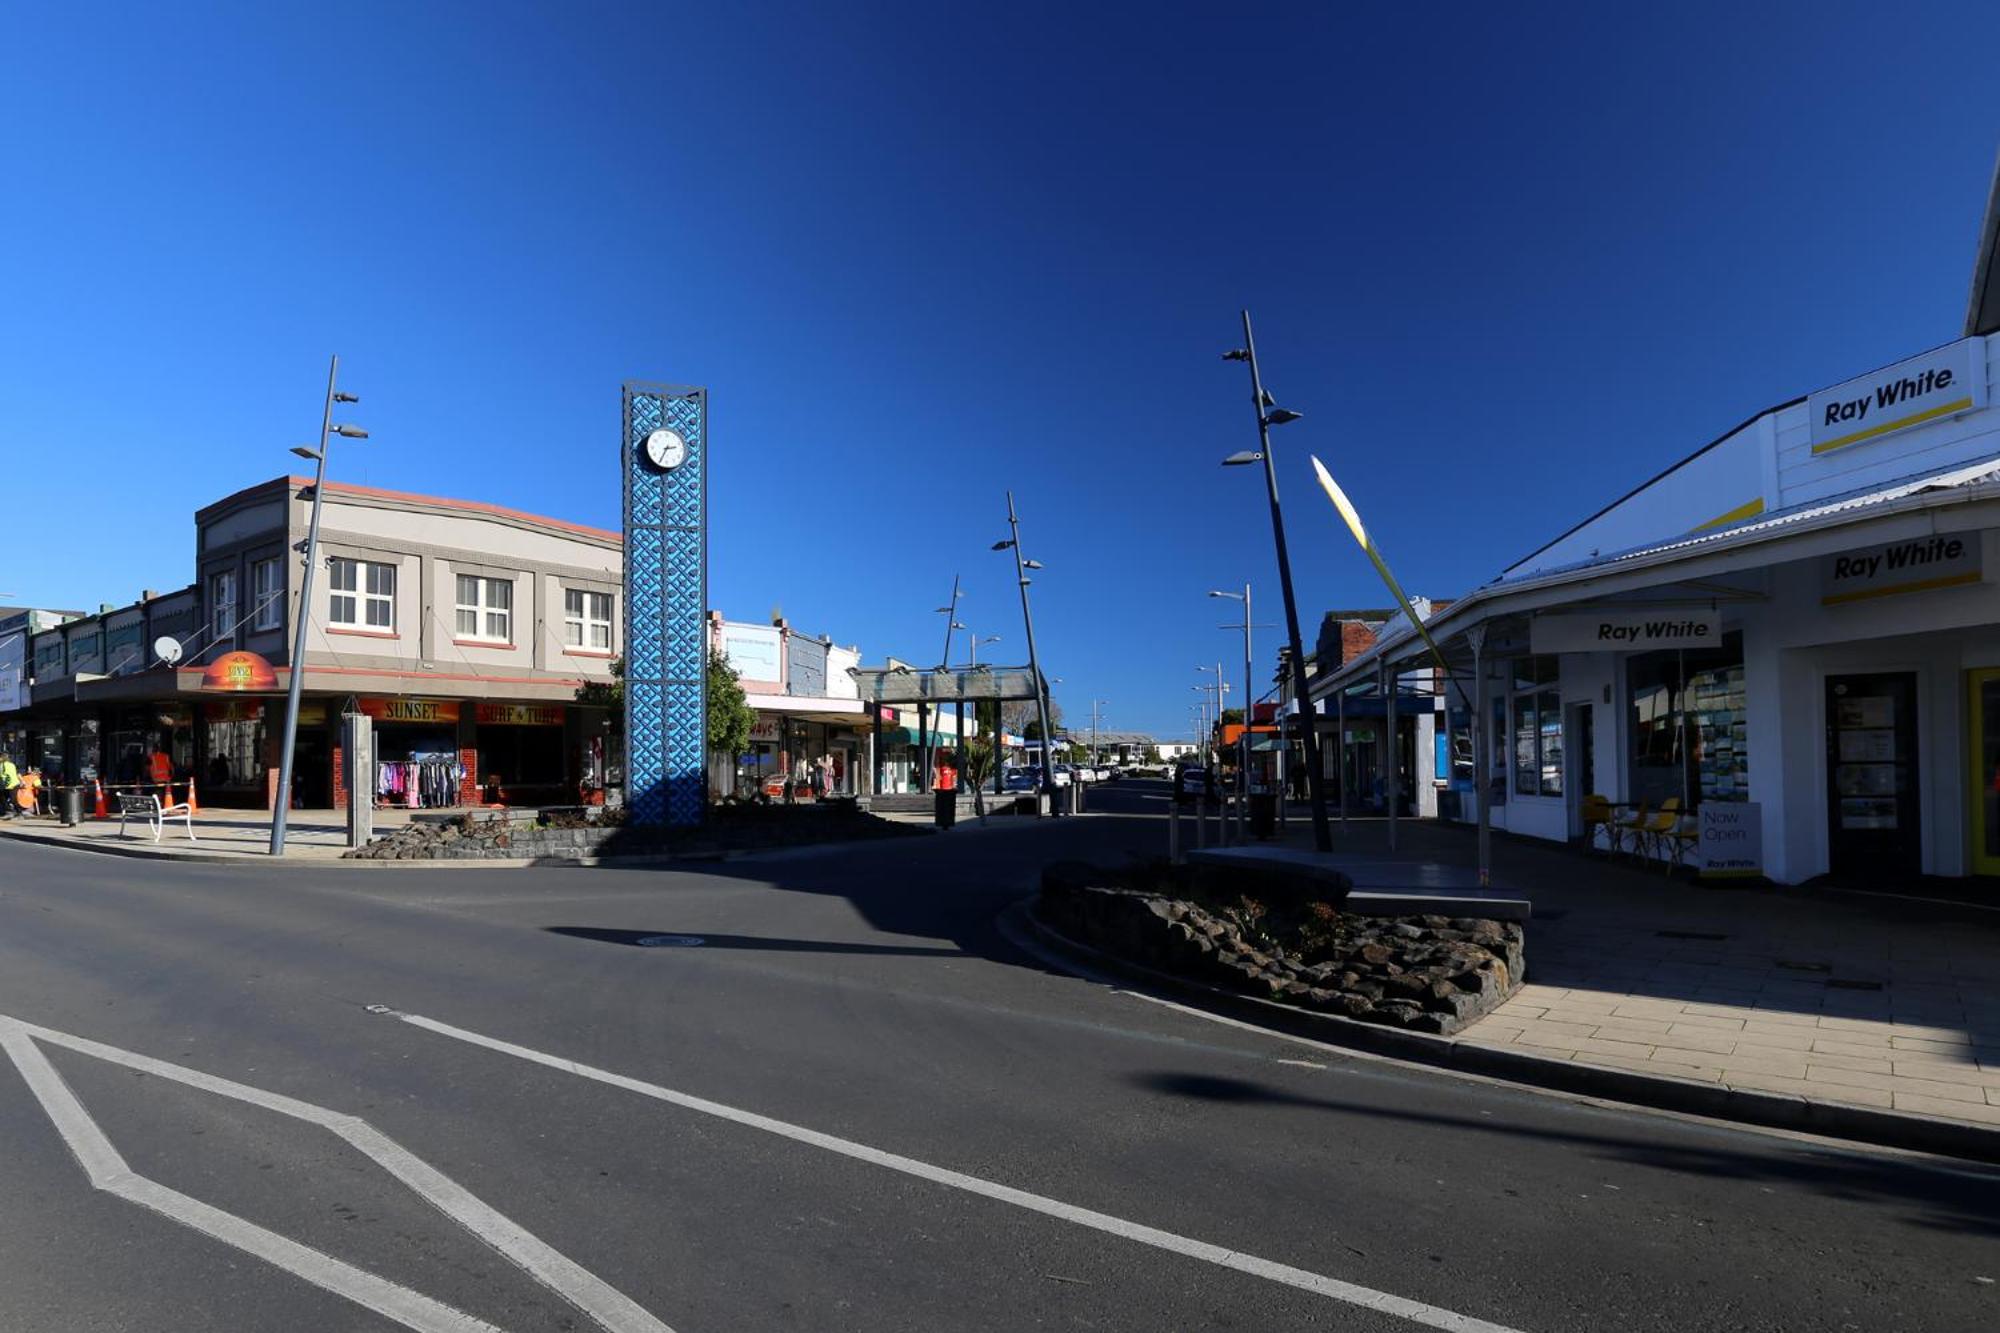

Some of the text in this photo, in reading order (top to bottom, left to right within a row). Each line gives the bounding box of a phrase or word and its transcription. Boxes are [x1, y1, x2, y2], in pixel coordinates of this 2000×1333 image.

[1824, 368, 1953, 426] Ray White
[1834, 537, 1963, 580] Ray White
[1598, 620, 1709, 642] Ray White
[385, 702, 440, 720] SUNSET
[483, 705, 514, 722] SURF
[1704, 811, 1739, 825] Now
[1704, 827, 1747, 843] Open
[1707, 859, 1756, 868] Ray White
